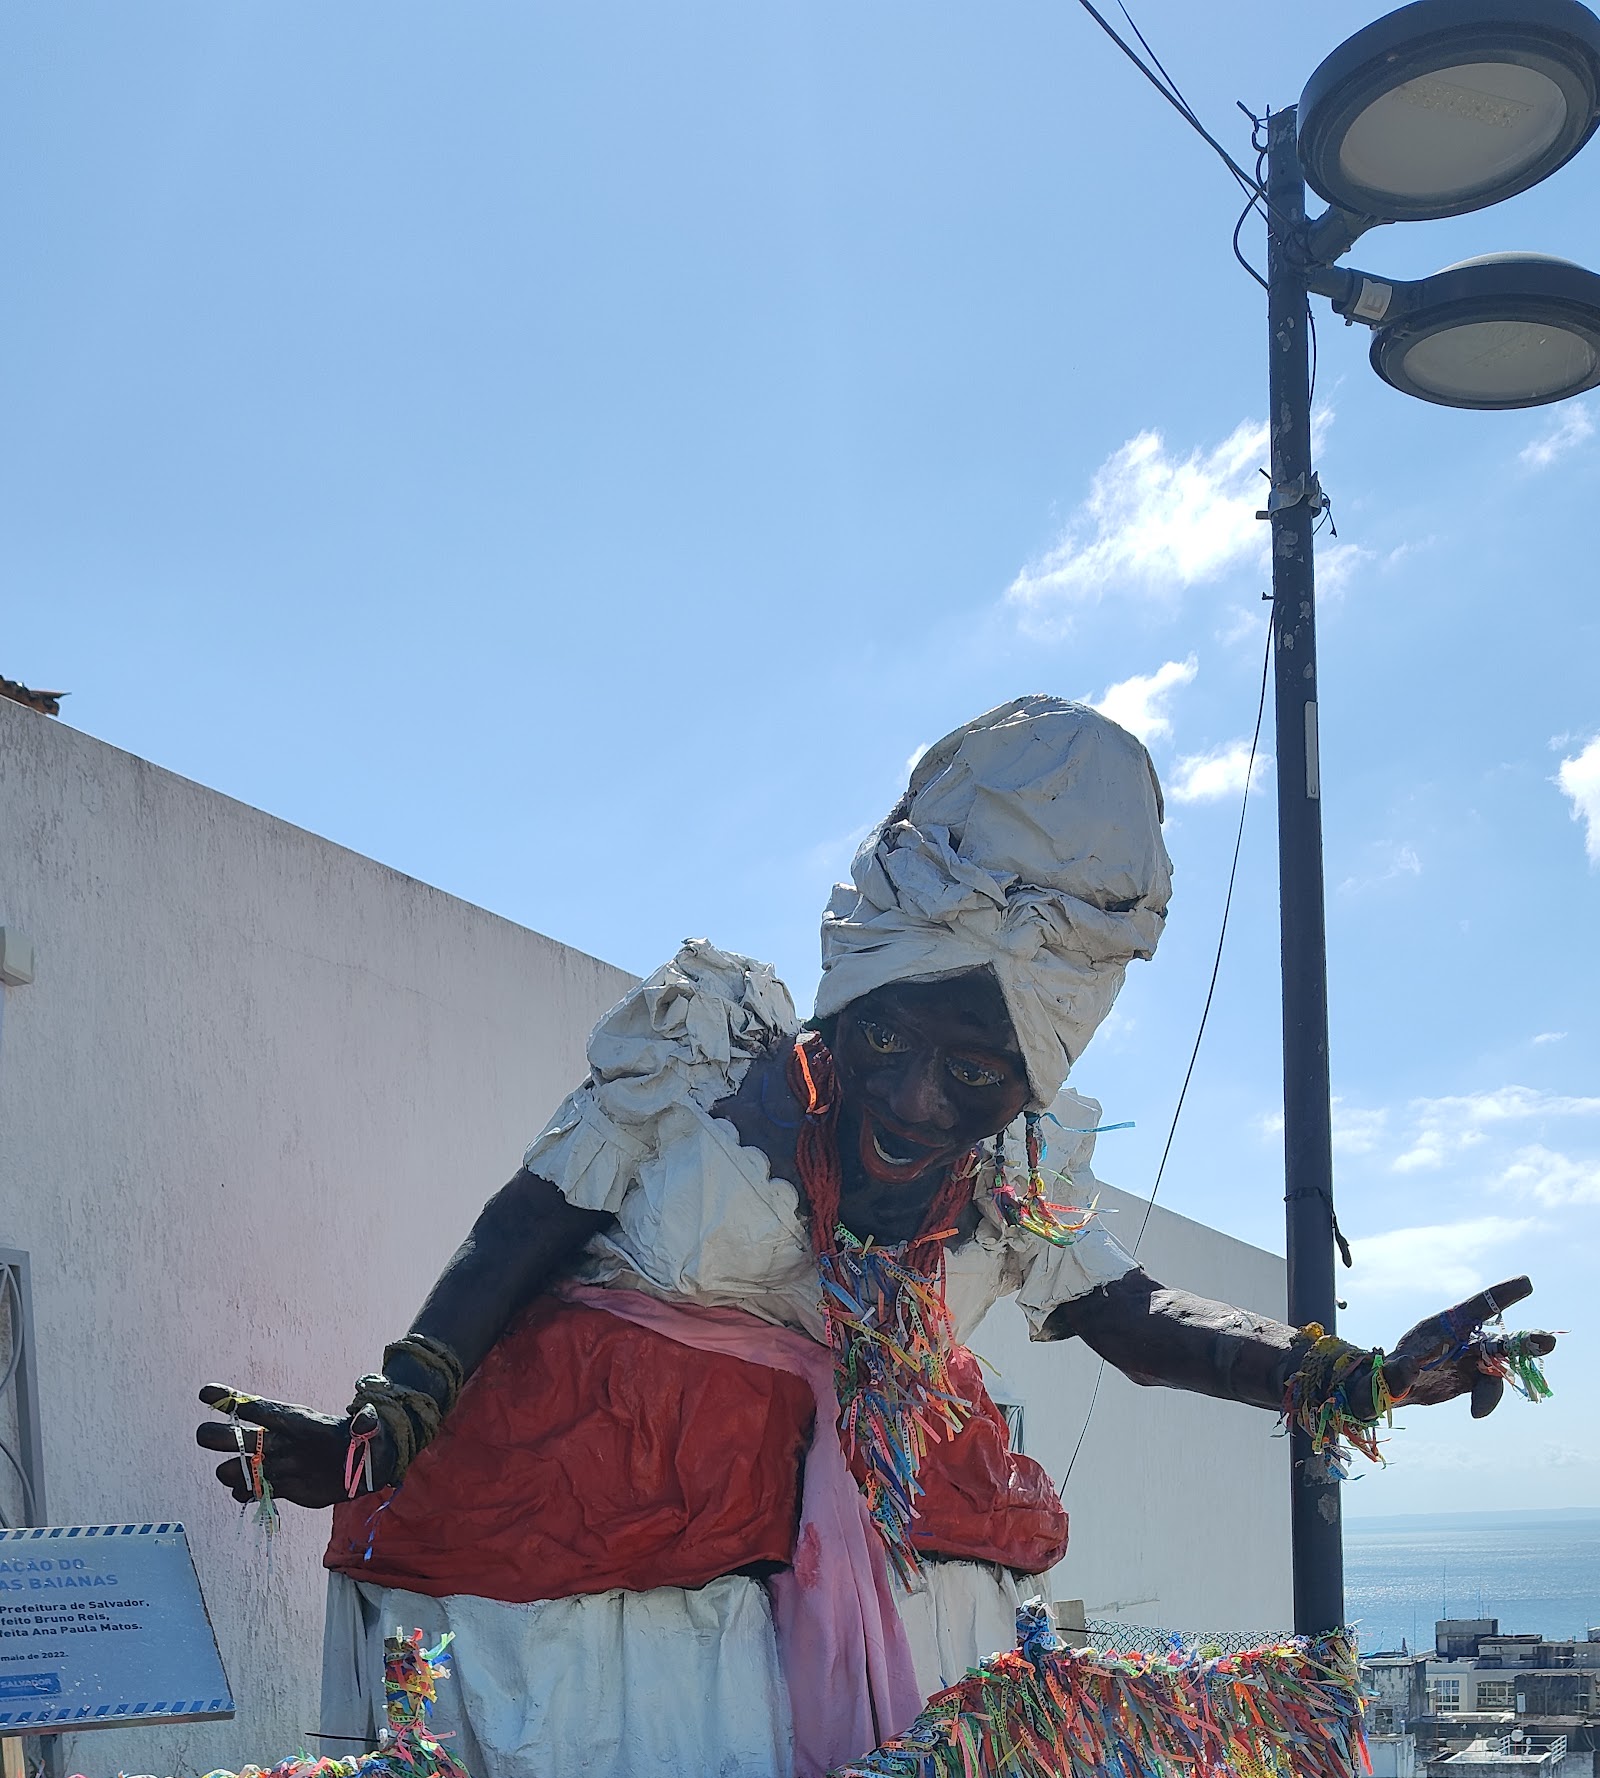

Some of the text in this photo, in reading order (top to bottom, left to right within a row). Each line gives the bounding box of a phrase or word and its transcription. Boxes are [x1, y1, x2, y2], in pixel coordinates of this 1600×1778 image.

[60, 1559, 84, 1571] DO
[29, 1574, 118, 1589] BAIANAS
[0, 1599, 151, 1613] Prefeitura de Salvador,
[34, 1614, 75, 1624] Bruno
[78, 1612, 110, 1622] Reis,
[32, 1627, 58, 1636] Ana
[60, 1624, 98, 1634] Paula
[100, 1622, 144, 1633] Matos.
[1, 1651, 69, 1662] maio de 2022.
[0, 1678, 53, 1689] SALVADOR
